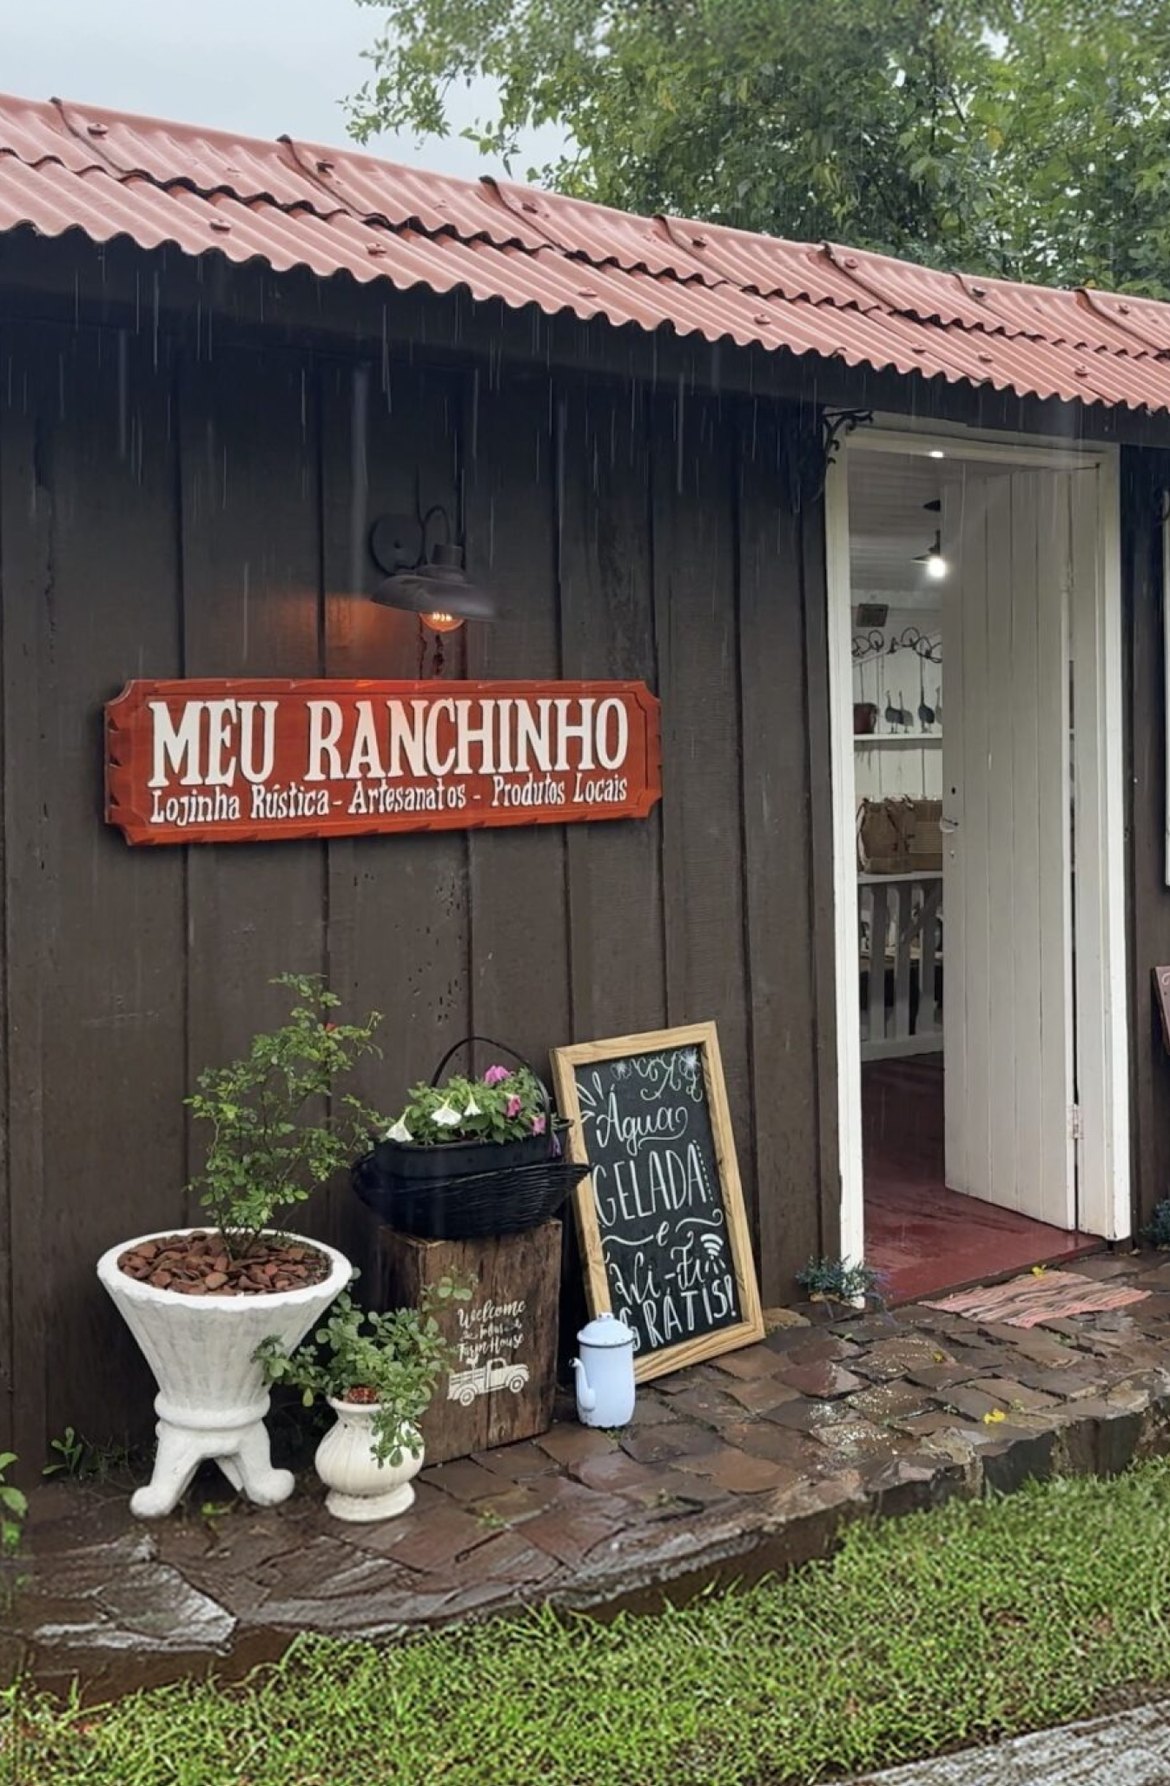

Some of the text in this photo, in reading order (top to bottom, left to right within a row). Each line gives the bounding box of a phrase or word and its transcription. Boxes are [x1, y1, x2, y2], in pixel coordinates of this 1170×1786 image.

[147, 697, 628, 787] MEU RANCHINHO
[150, 786, 240, 826] Lojinha
[250, 782, 330, 819] Rústica
[348, 780, 466, 814] Artesanatos
[492, 772, 566, 807] Produtos
[572, 772, 628, 806] Locais
[596, 1084, 688, 1156] Água
[593, 1143, 707, 1227] GELADA
[656, 1222, 670, 1246] e
[457, 1299, 526, 1329] Welcome
